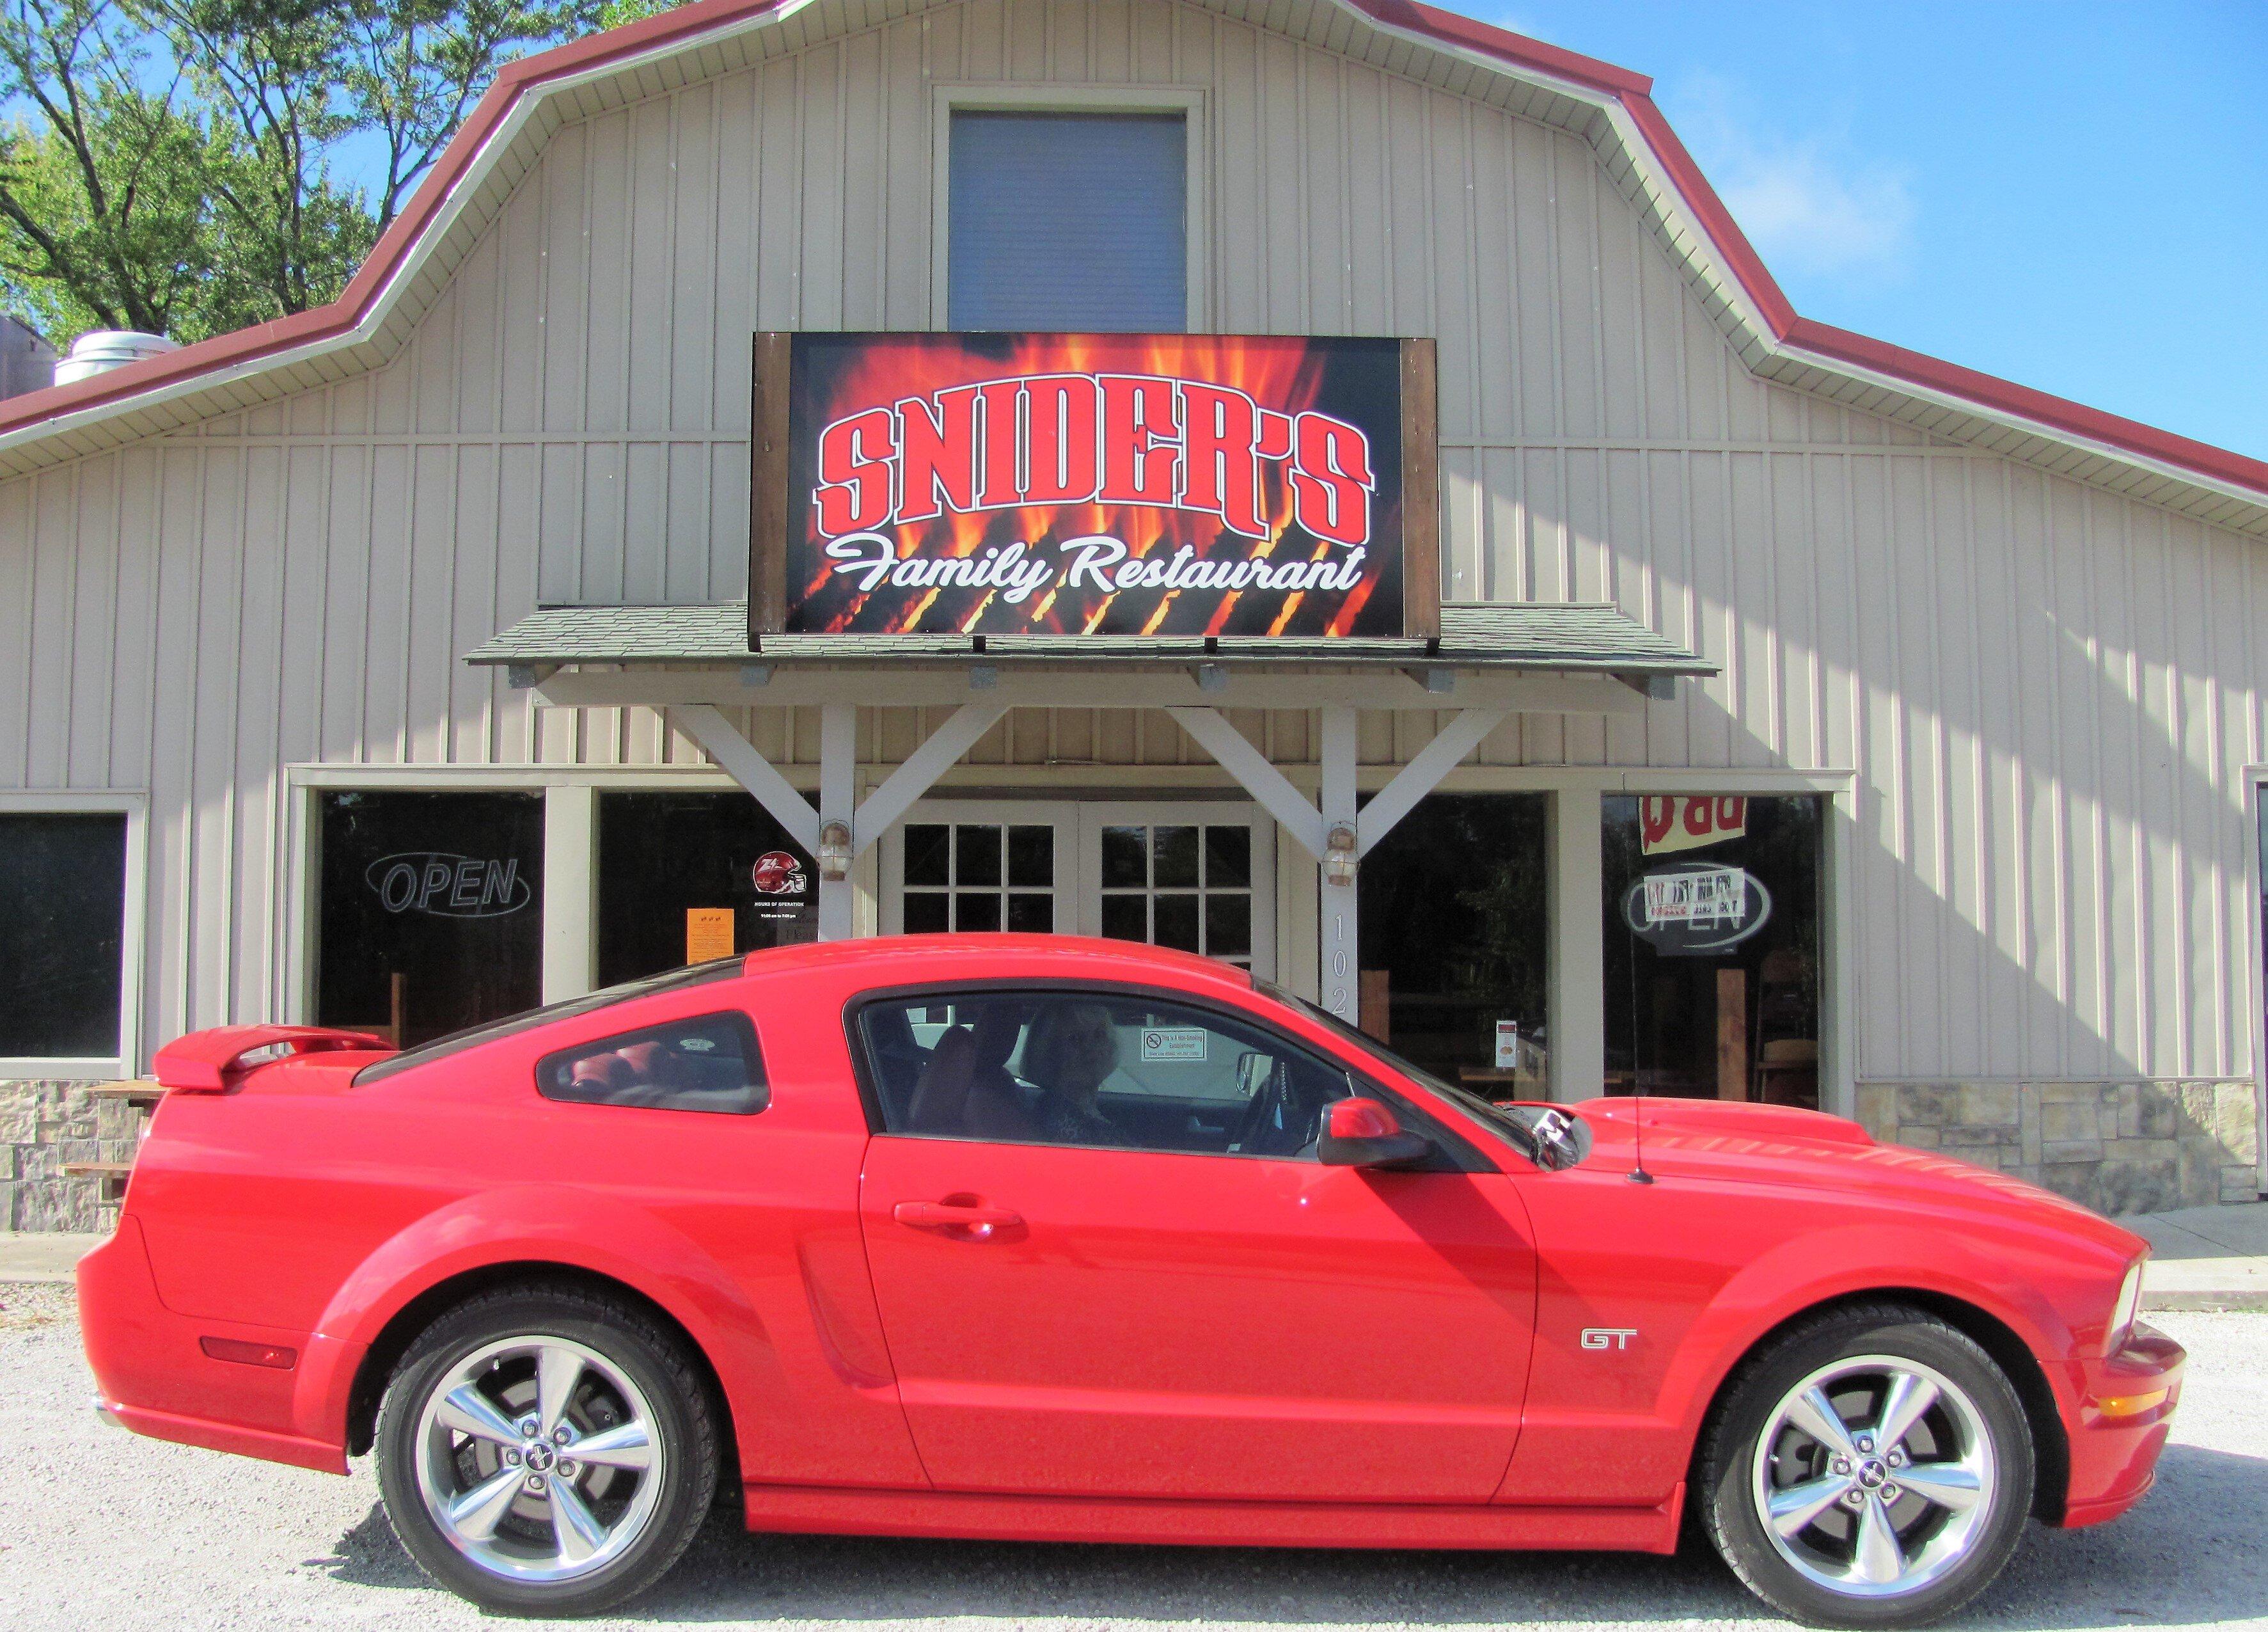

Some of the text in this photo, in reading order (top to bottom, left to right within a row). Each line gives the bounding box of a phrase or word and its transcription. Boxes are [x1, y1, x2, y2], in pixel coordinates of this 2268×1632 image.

[812, 372, 1376, 547] SNIDER'S
[825, 534, 1366, 604] Family Restaurant
[381, 859, 518, 913] OPEN
[1580, 1327, 1637, 1350] GT
